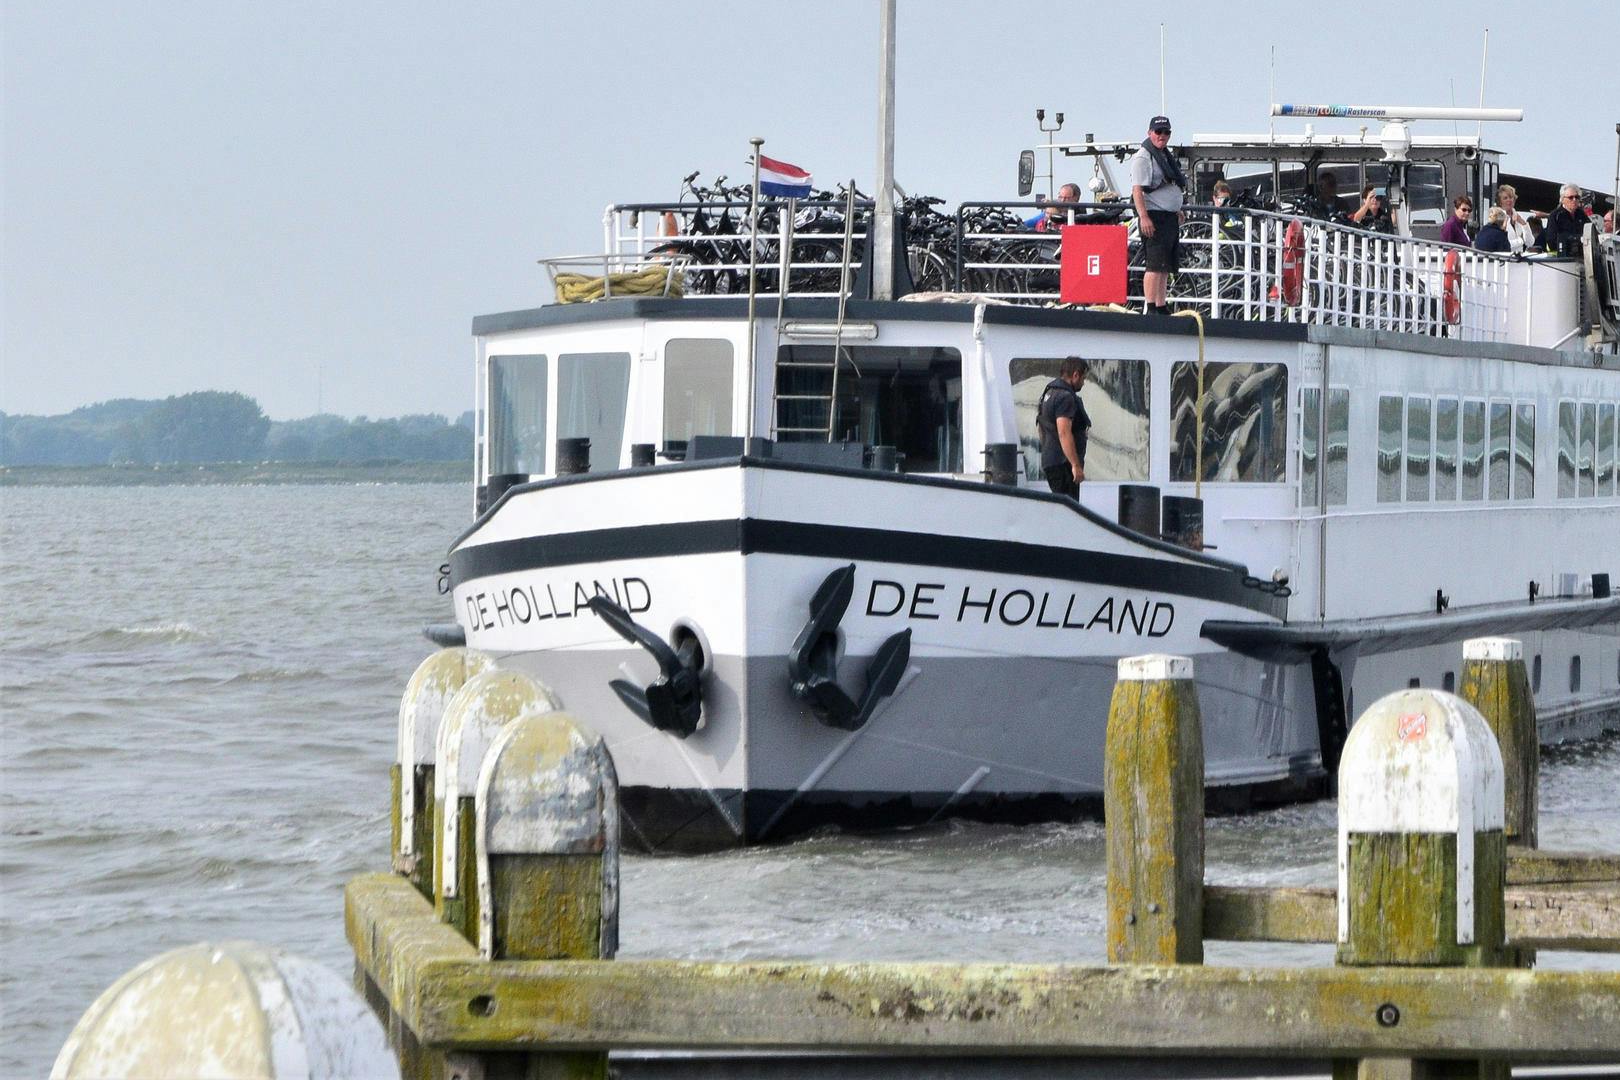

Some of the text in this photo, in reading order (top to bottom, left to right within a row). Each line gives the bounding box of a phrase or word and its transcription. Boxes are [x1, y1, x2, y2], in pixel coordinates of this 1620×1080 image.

[1347, 106, 1386, 116] Rasterscan
[466, 577, 651, 631] DE HOLLAND
[866, 580, 1175, 638] DE HOLLAND
